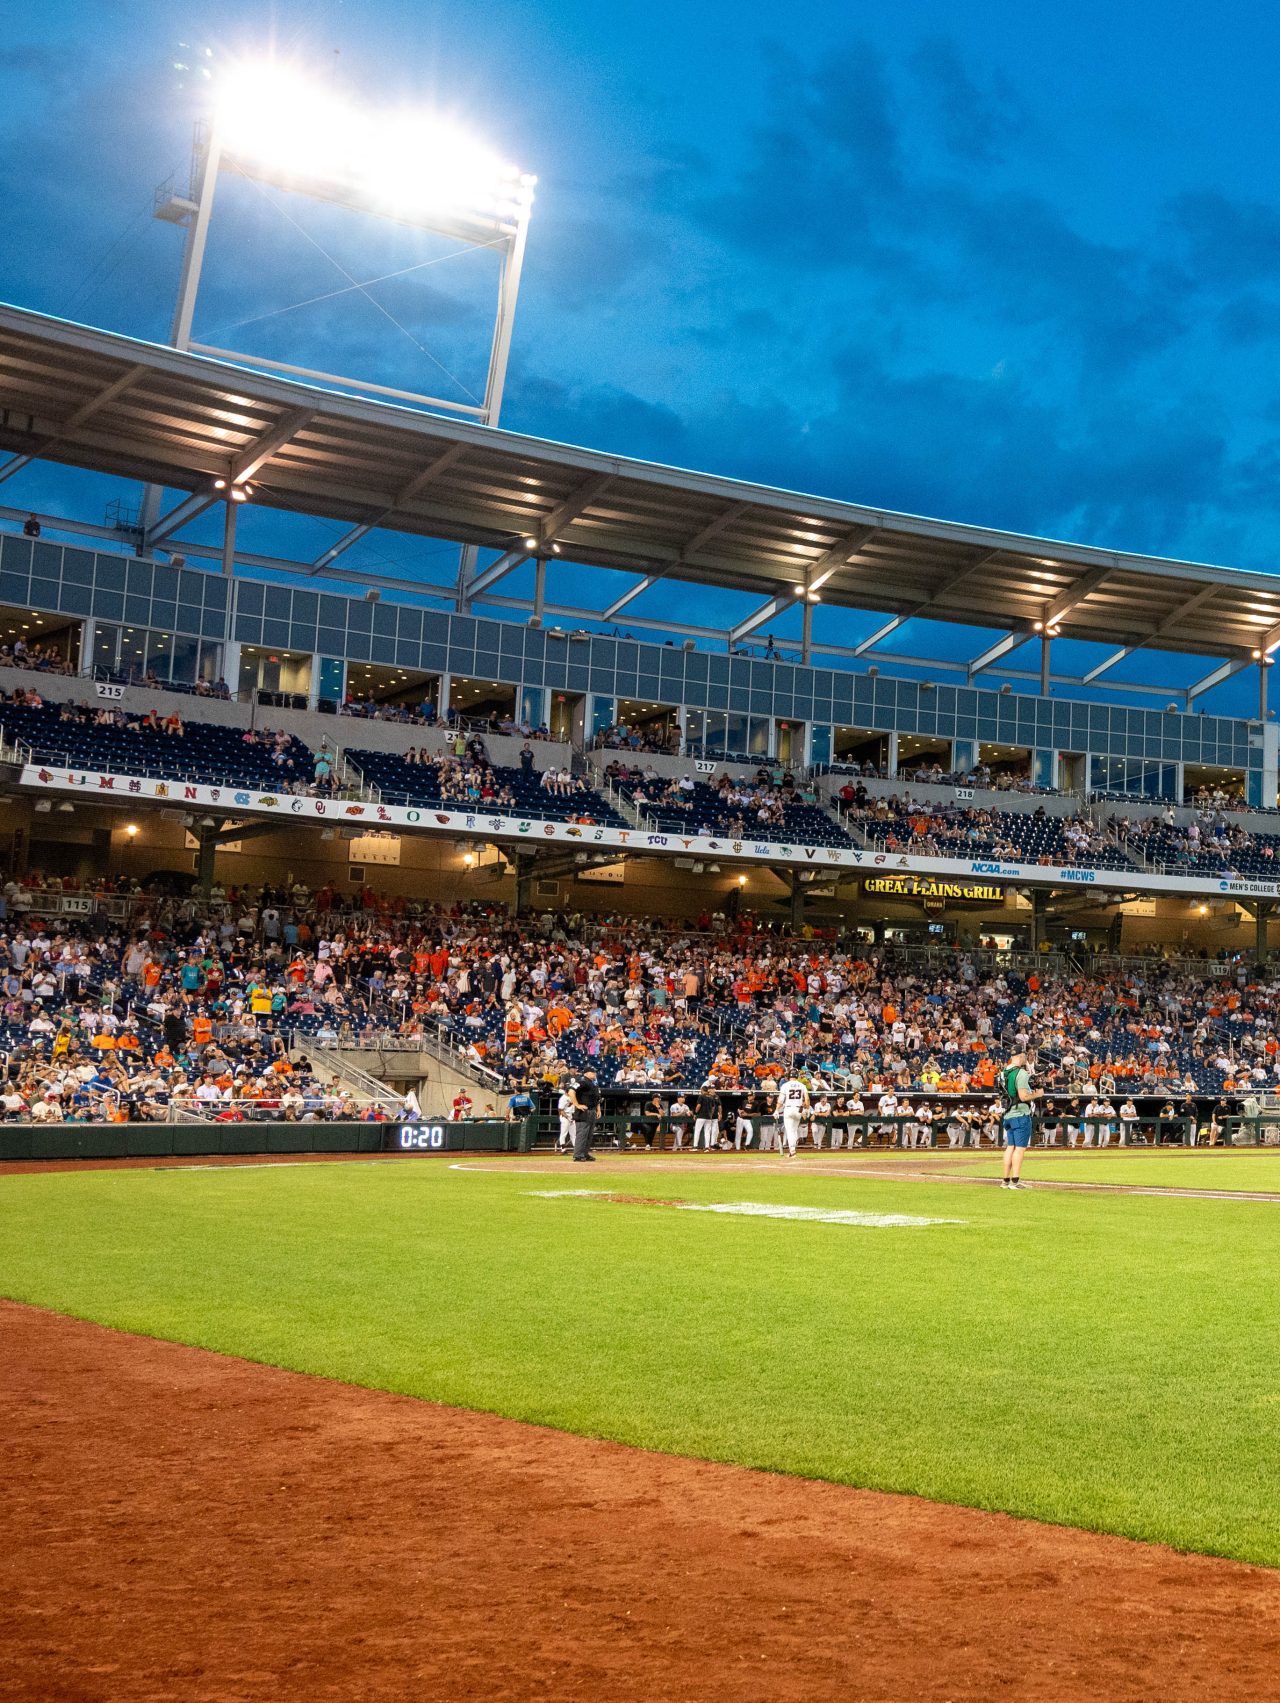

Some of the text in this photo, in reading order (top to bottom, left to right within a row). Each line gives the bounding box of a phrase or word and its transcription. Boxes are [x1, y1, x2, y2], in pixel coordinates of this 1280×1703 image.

[99, 686, 122, 697] 215
[697, 763, 714, 771] 217
[184, 786, 198, 799] N
[957, 790, 973, 798] 218
[406, 810, 421, 822] O
[618, 831, 630, 843] T
[647, 835, 668, 846] TCU
[971, 862, 1020, 876] NCAA.com
[1060, 869, 1095, 882] #MCWS
[1229, 882, 1249, 892] MEN'S
[1249, 884, 1275, 893] COLLEGE
[66, 900, 88, 910] 115
[788, 1089, 802, 1100] 23
[401, 1126, 443, 1148] 0:20
